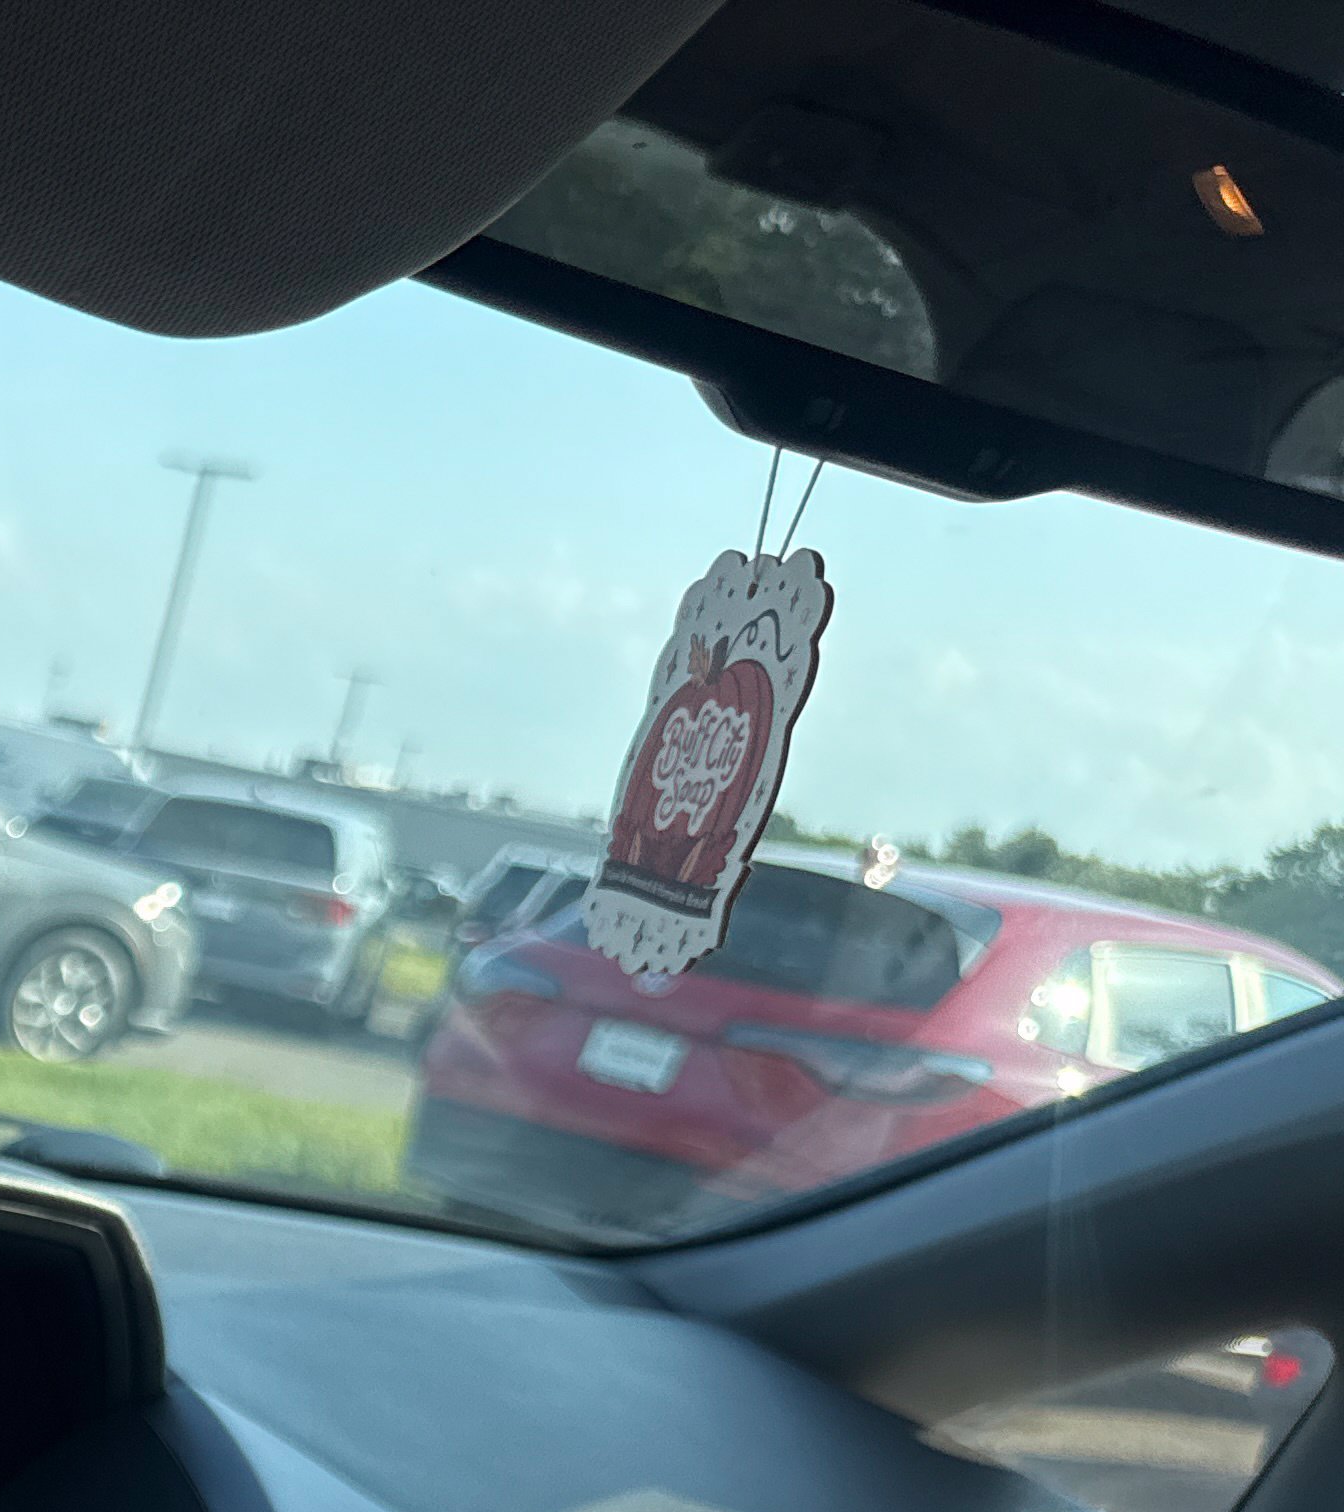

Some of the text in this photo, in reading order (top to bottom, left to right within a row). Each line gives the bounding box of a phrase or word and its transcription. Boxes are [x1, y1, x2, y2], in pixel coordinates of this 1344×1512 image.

[657, 710, 745, 781] Buff City
[659, 768, 715, 826] Soap
